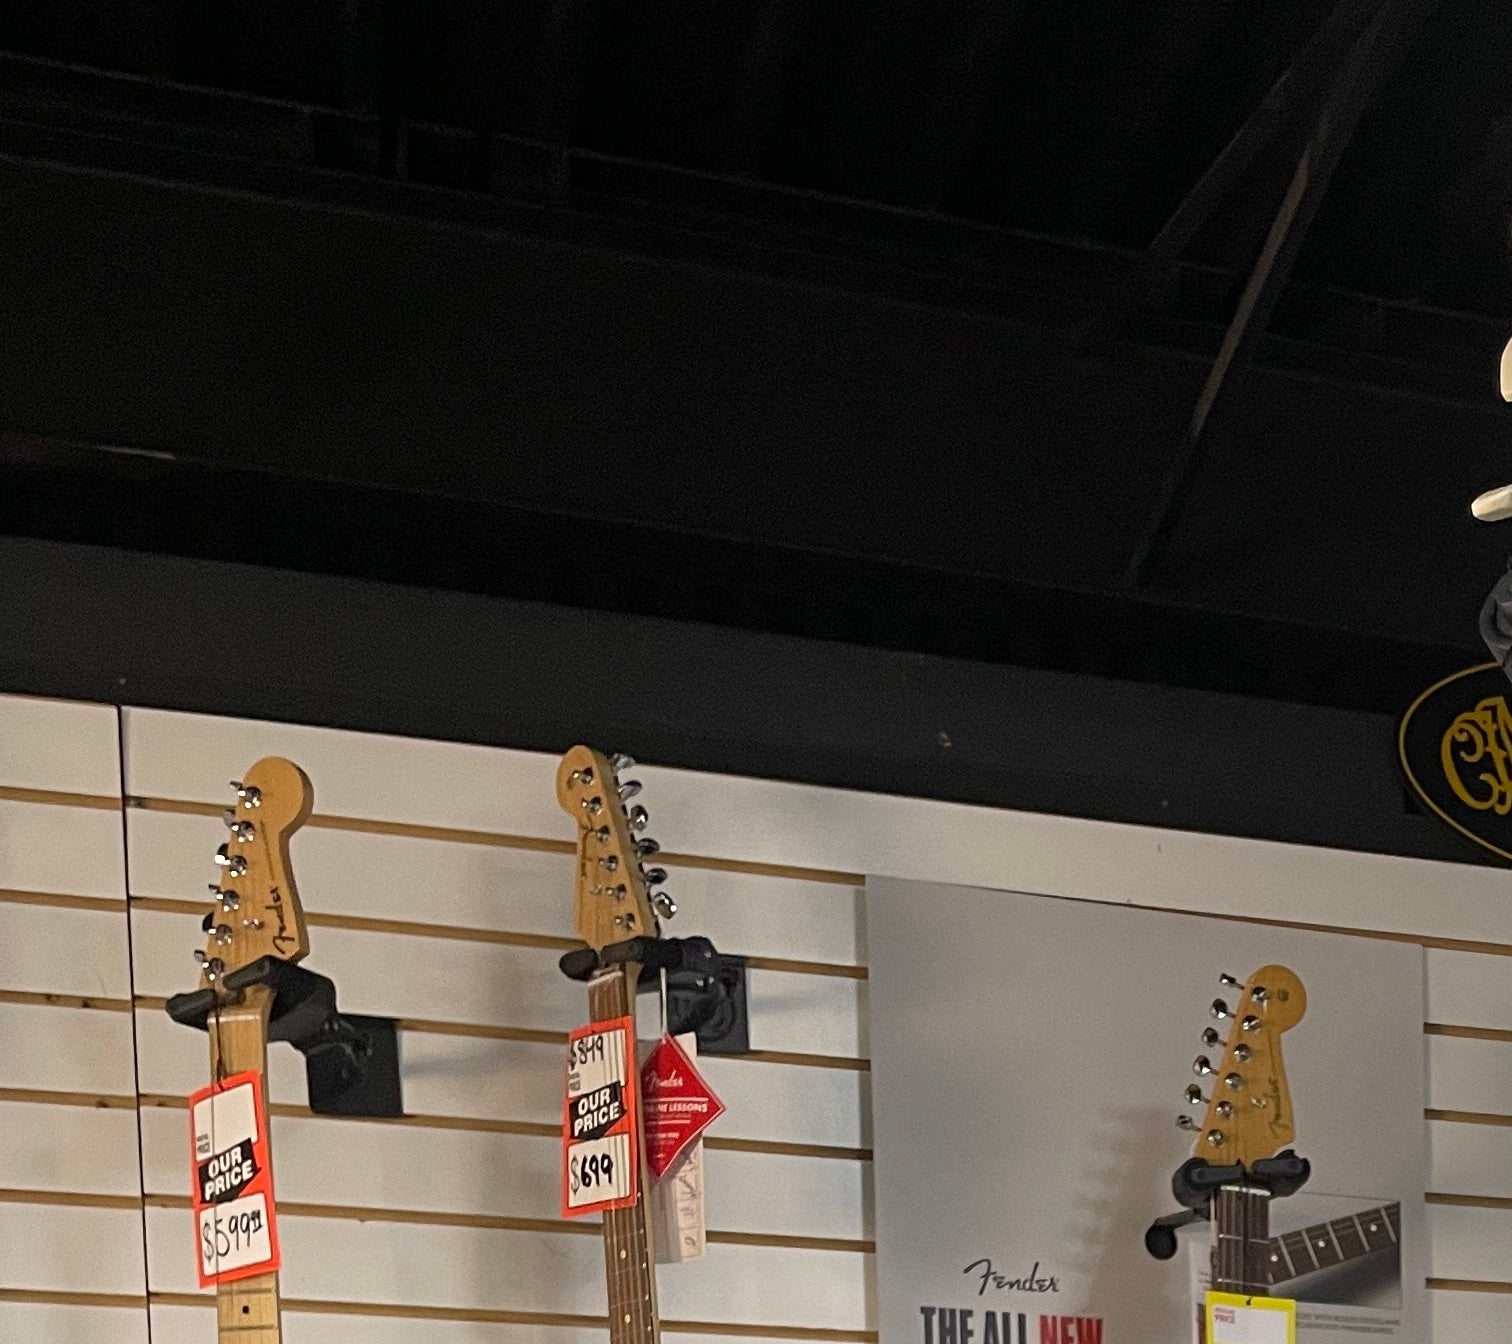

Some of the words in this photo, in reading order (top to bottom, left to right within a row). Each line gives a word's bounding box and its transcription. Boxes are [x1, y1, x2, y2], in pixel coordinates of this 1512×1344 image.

[573, 1102, 621, 1139] PRICE
[578, 1089, 611, 1115] OUR
[204, 1160, 254, 1201] PRICE
[207, 1146, 243, 1178] OUR
[570, 1154, 614, 1195] $699
[963, 1258, 1061, 1296] Fender
